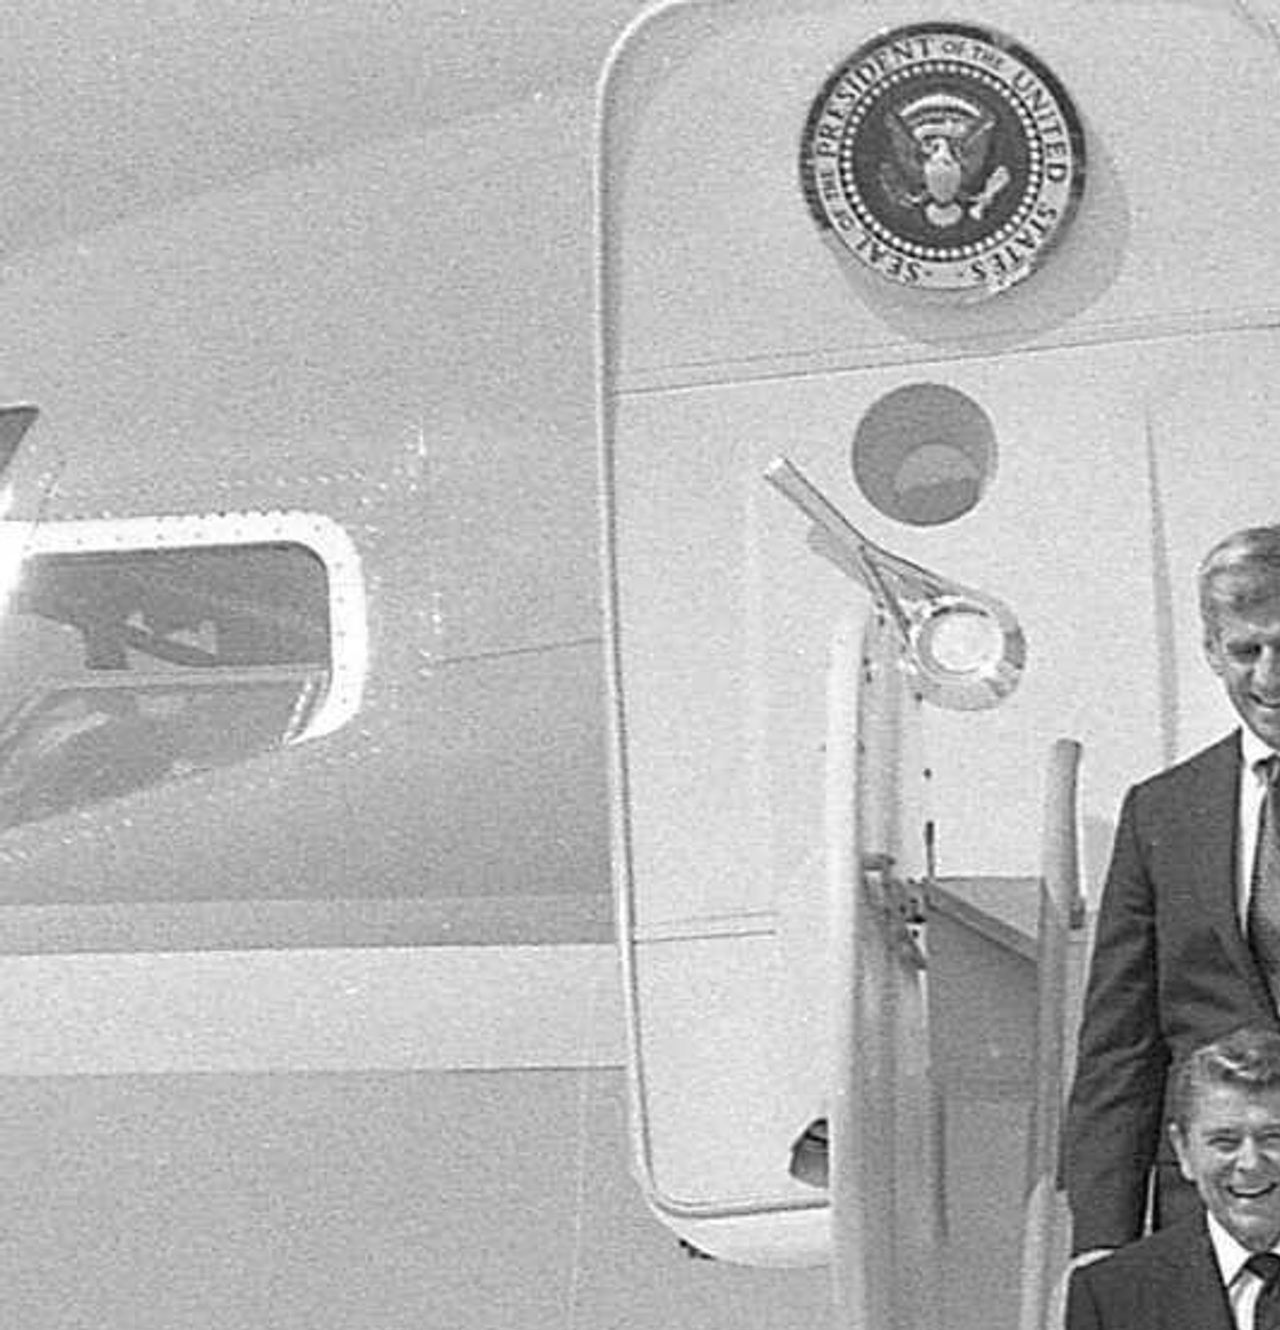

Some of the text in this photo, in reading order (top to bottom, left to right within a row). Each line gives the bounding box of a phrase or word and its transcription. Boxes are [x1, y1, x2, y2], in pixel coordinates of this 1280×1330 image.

[816, 38, 931, 157] PRESIDENT
[1013, 69, 1067, 183] UNITED
[857, 236, 921, 282] SEAL
[970, 206, 1058, 282] STATES
